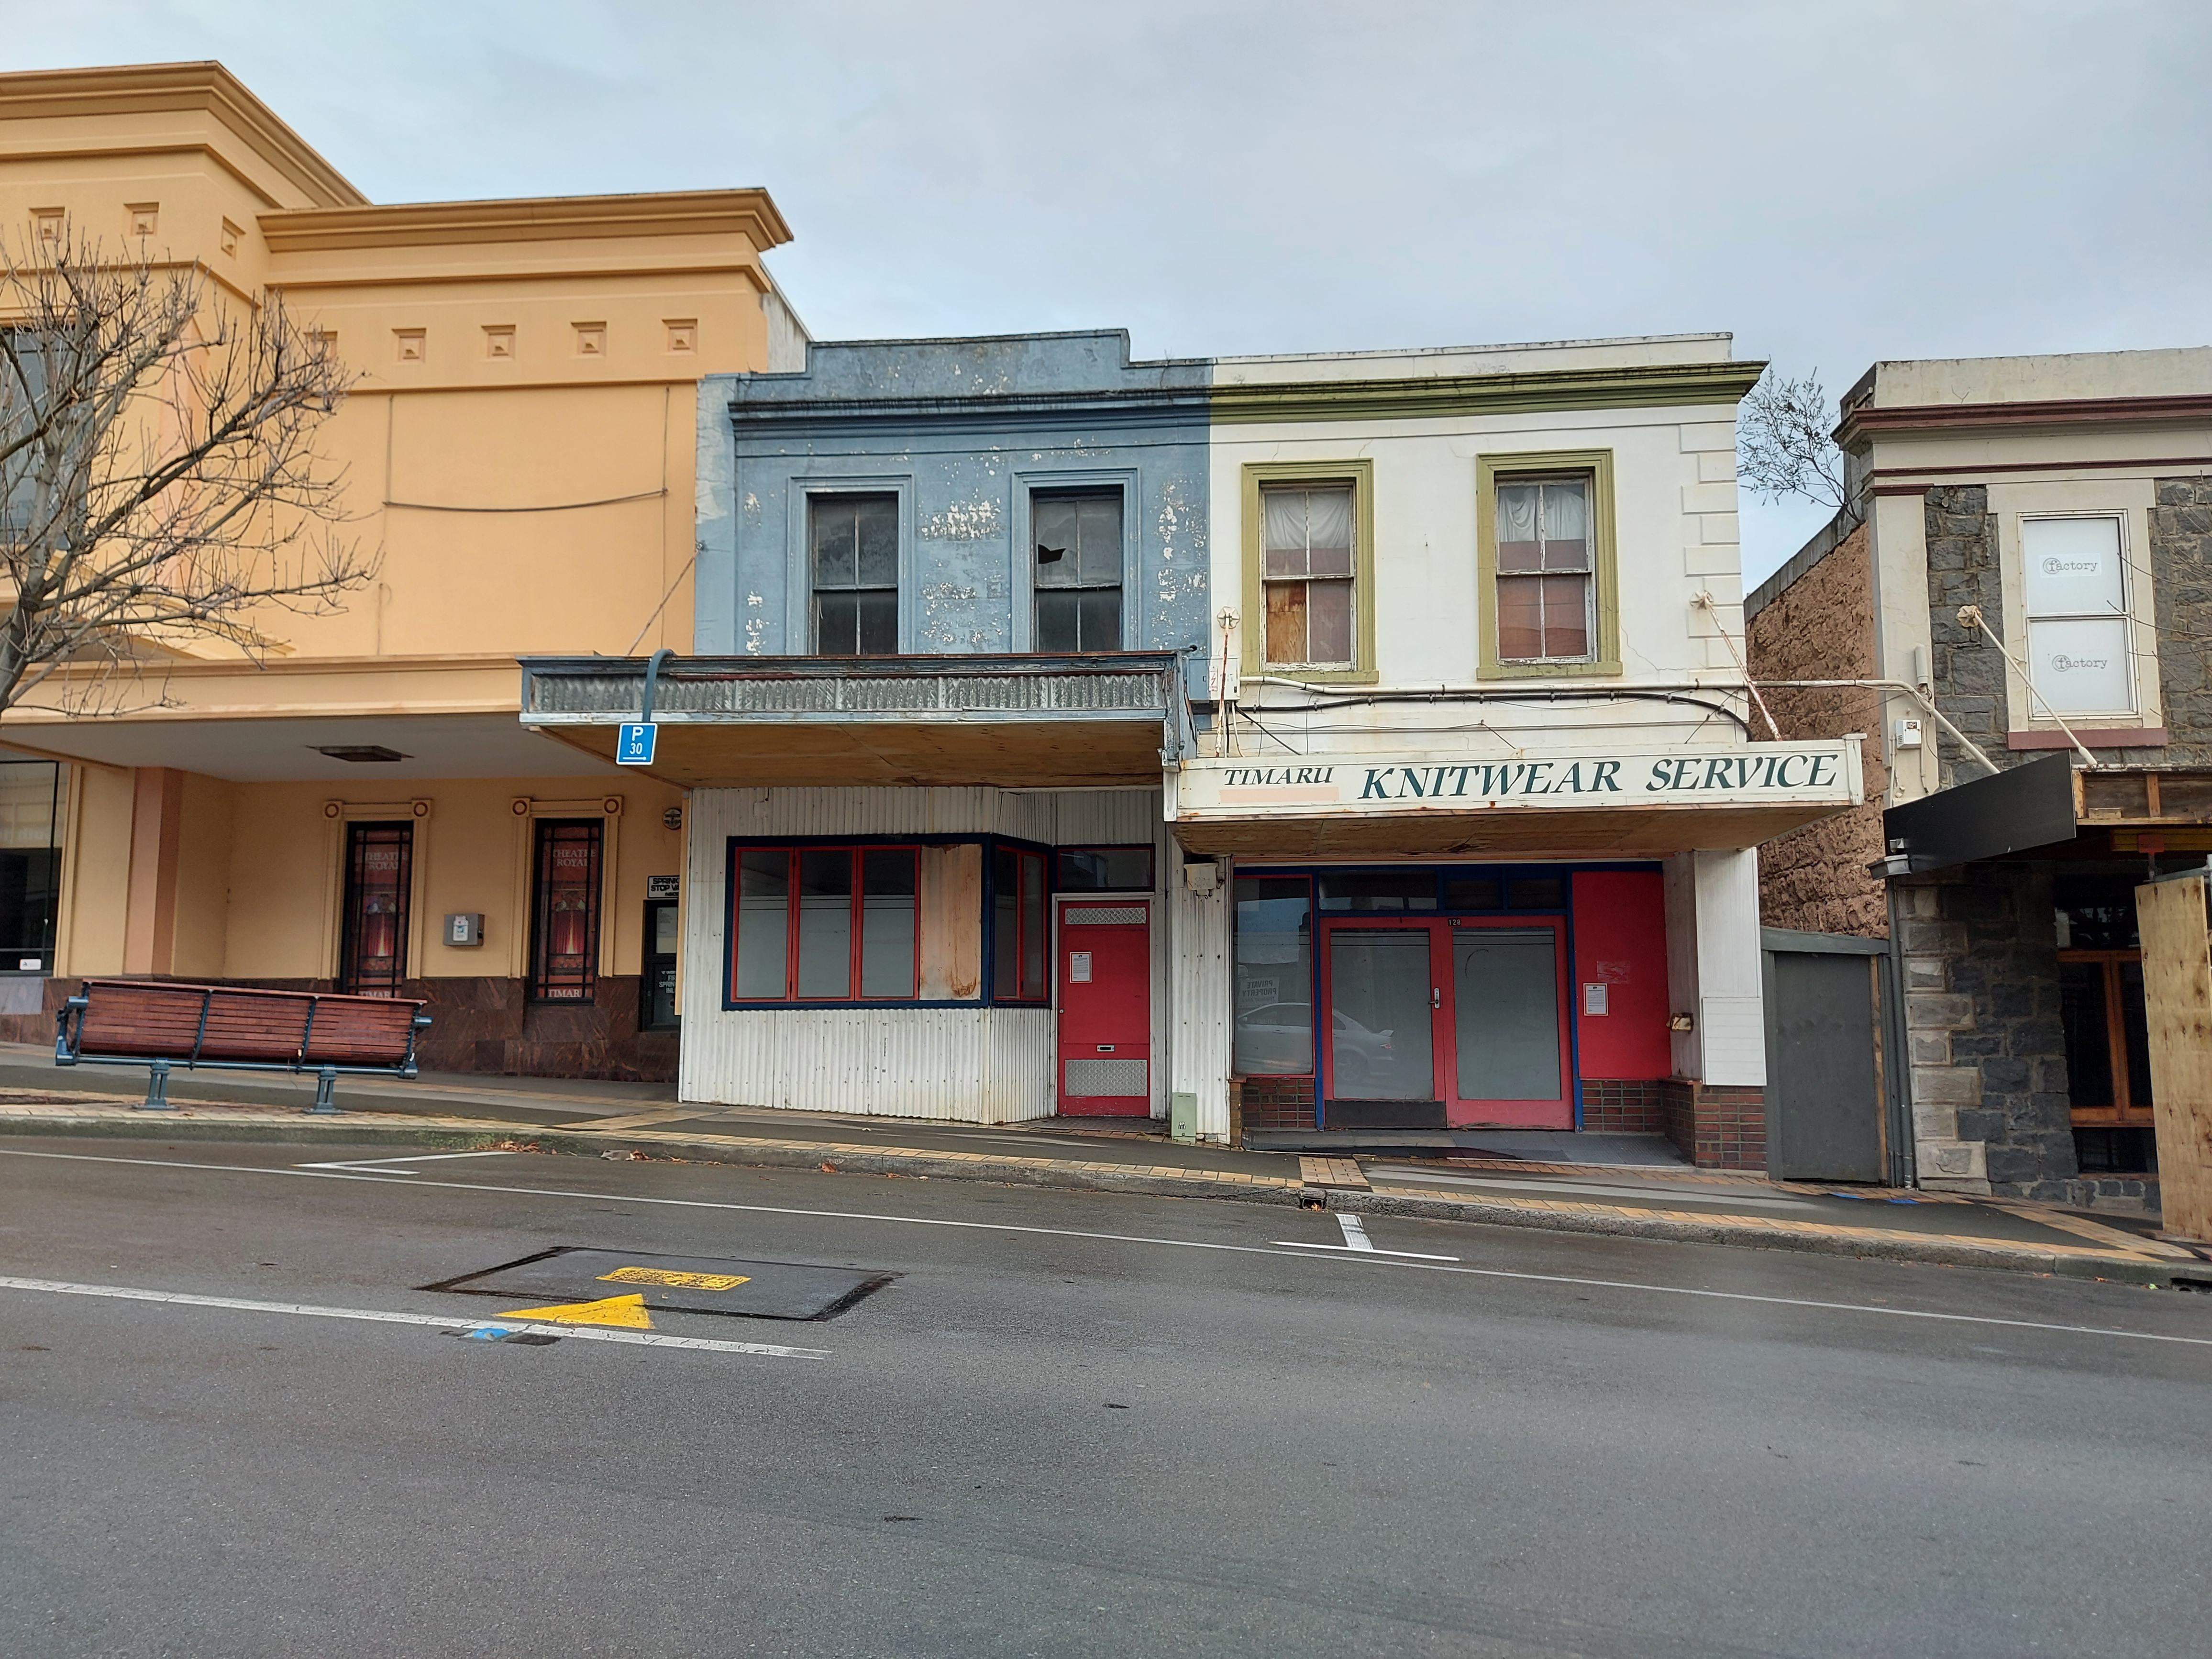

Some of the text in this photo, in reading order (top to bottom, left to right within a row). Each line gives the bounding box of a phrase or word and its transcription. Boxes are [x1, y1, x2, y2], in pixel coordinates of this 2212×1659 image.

[2046, 559, 2098, 573] factory
[2055, 656, 2108, 670] factory
[631, 726, 644, 741] P
[629, 742, 643, 754] 30
[1224, 754, 1838, 799] TIMARU KNITWEAR SERVICE
[365, 852, 407, 861] THEATE
